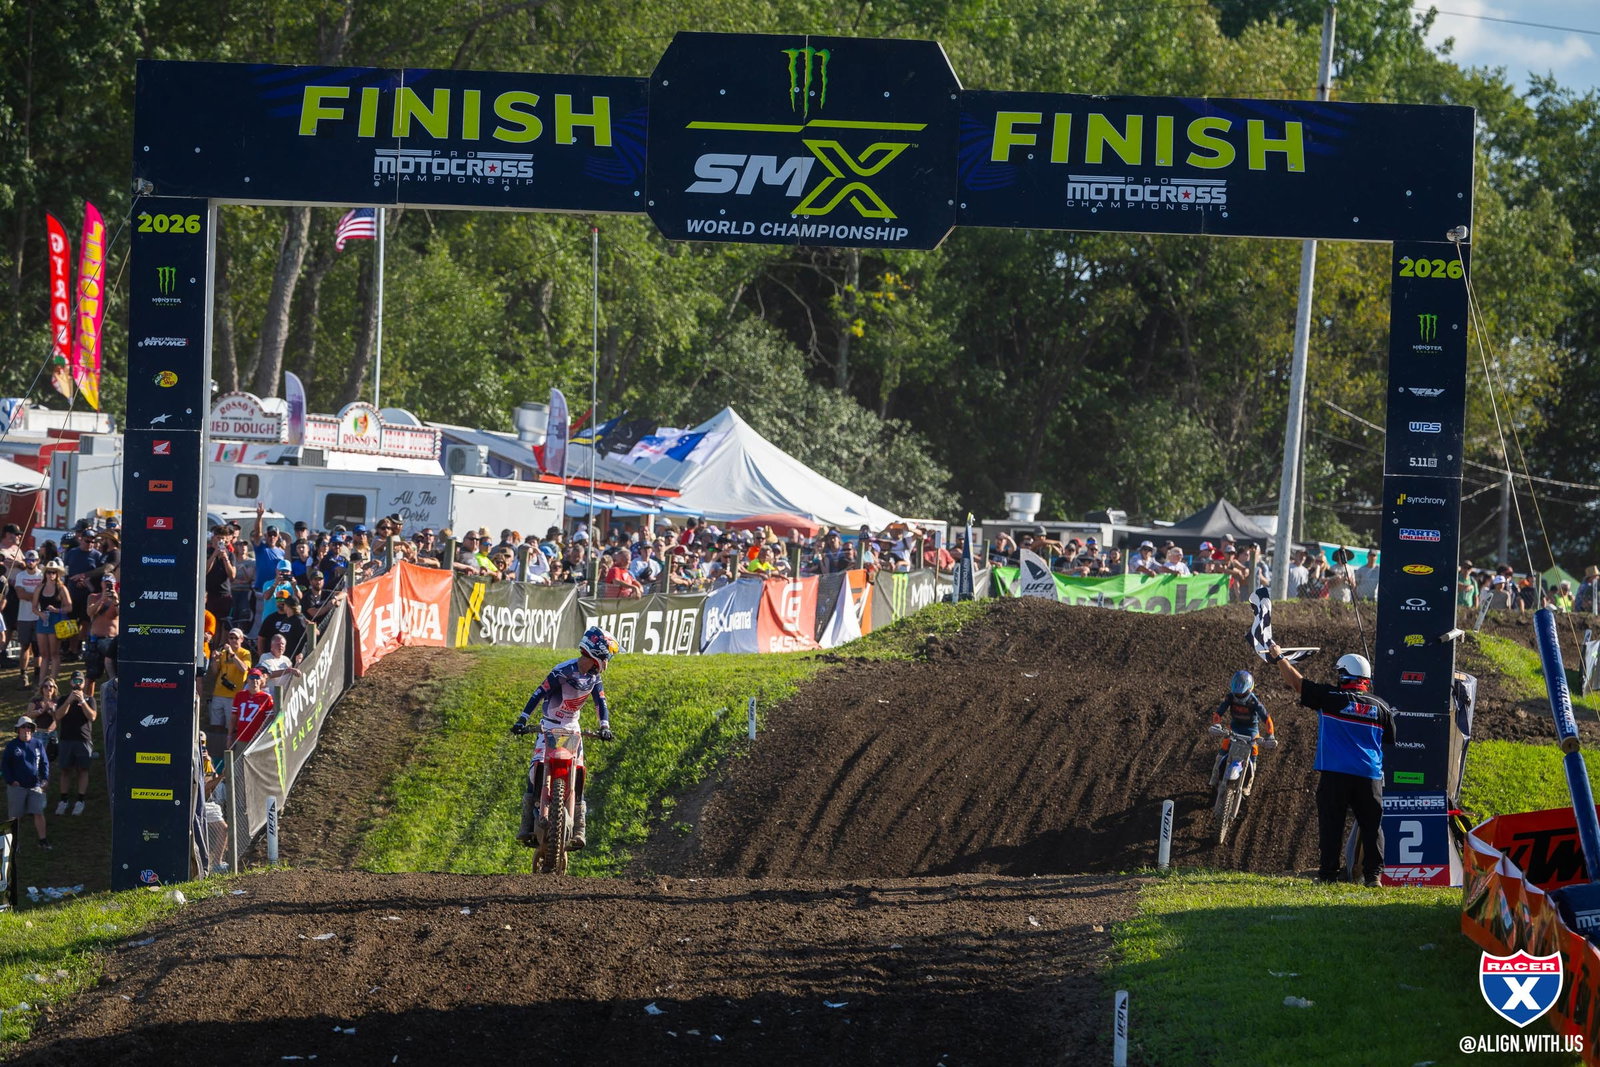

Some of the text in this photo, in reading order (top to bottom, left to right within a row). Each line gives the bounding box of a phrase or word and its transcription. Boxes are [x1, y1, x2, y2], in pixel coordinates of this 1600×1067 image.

[299, 85, 612, 147] FINISH
[991, 111, 1305, 172] FINISH
[434, 150, 475, 159] PRO
[374, 156, 534, 178] MOTOCROSS
[374, 174, 534, 185] CHAMPIONSHIP
[684, 139, 910, 219] SMX
[1128, 176, 1169, 185] PRO
[1067, 182, 1227, 204] MOTOCROSS
[1067, 200, 1227, 212] CHAMPIONSHIP
[137, 213, 201, 234] 2026
[686, 219, 908, 241] WORLD CHAMPIONSHIP
[1399, 258, 1463, 279] 2026
[233, 422, 274, 434] DOUGH
[1409, 421, 1442, 433] WPS
[389, 490, 437, 506] All The
[1407, 495, 1446, 506] synchrony
[397, 507, 430, 522] Perks
[1400, 529, 1440, 537] PARTS
[480, 594, 562, 650] synchrony
[239, 702, 259, 722] 17
[1384, 799, 1445, 807] OTOCROSS
[1399, 820, 1424, 864] 2
